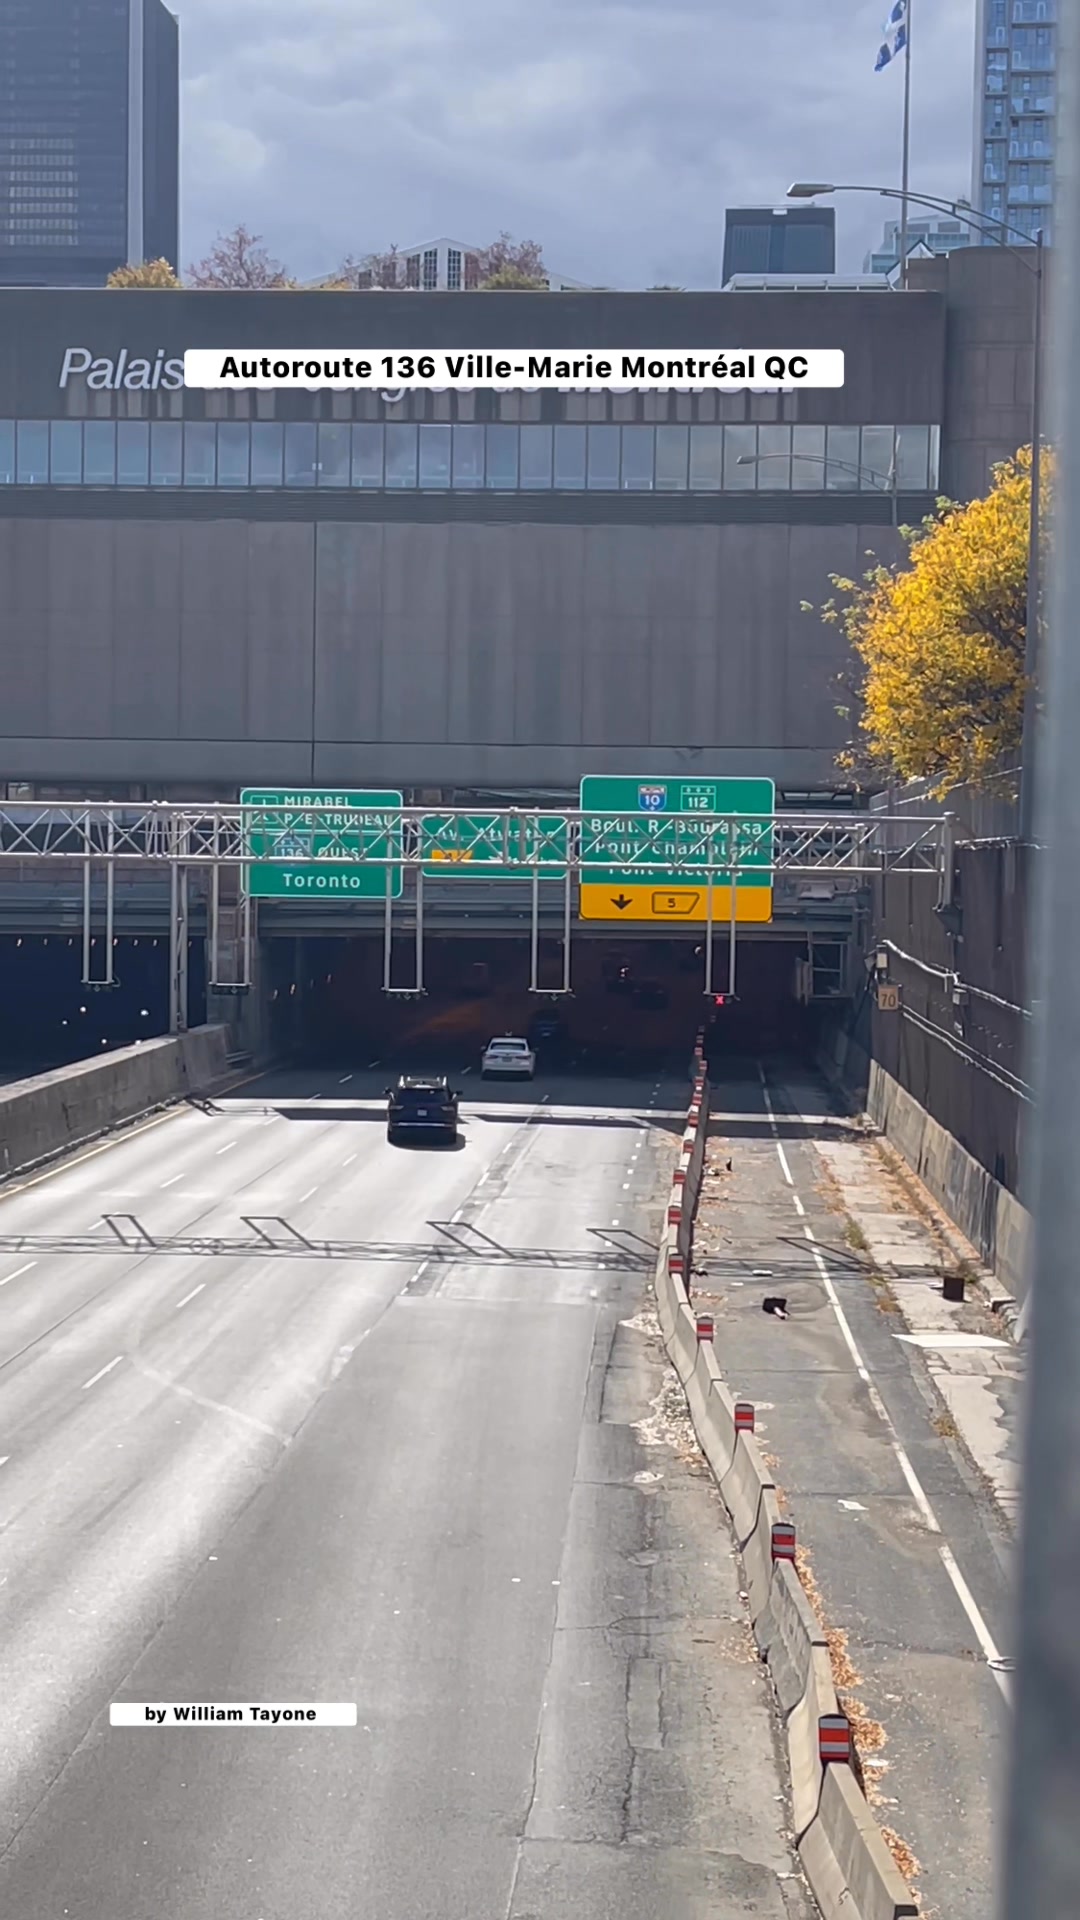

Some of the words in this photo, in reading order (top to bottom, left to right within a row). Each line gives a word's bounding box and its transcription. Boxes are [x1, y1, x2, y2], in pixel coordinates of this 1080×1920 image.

[59, 347, 185, 390] Palais
[284, 796, 352, 807] MIRABEL
[644, 796, 660, 805] 10
[688, 797, 709, 808] 112
[591, 818, 639, 833] Boul.
[280, 848, 304, 857] 136
[283, 873, 361, 889] Toronto
[667, 898, 676, 908] 5
[881, 993, 896, 1007] 70
